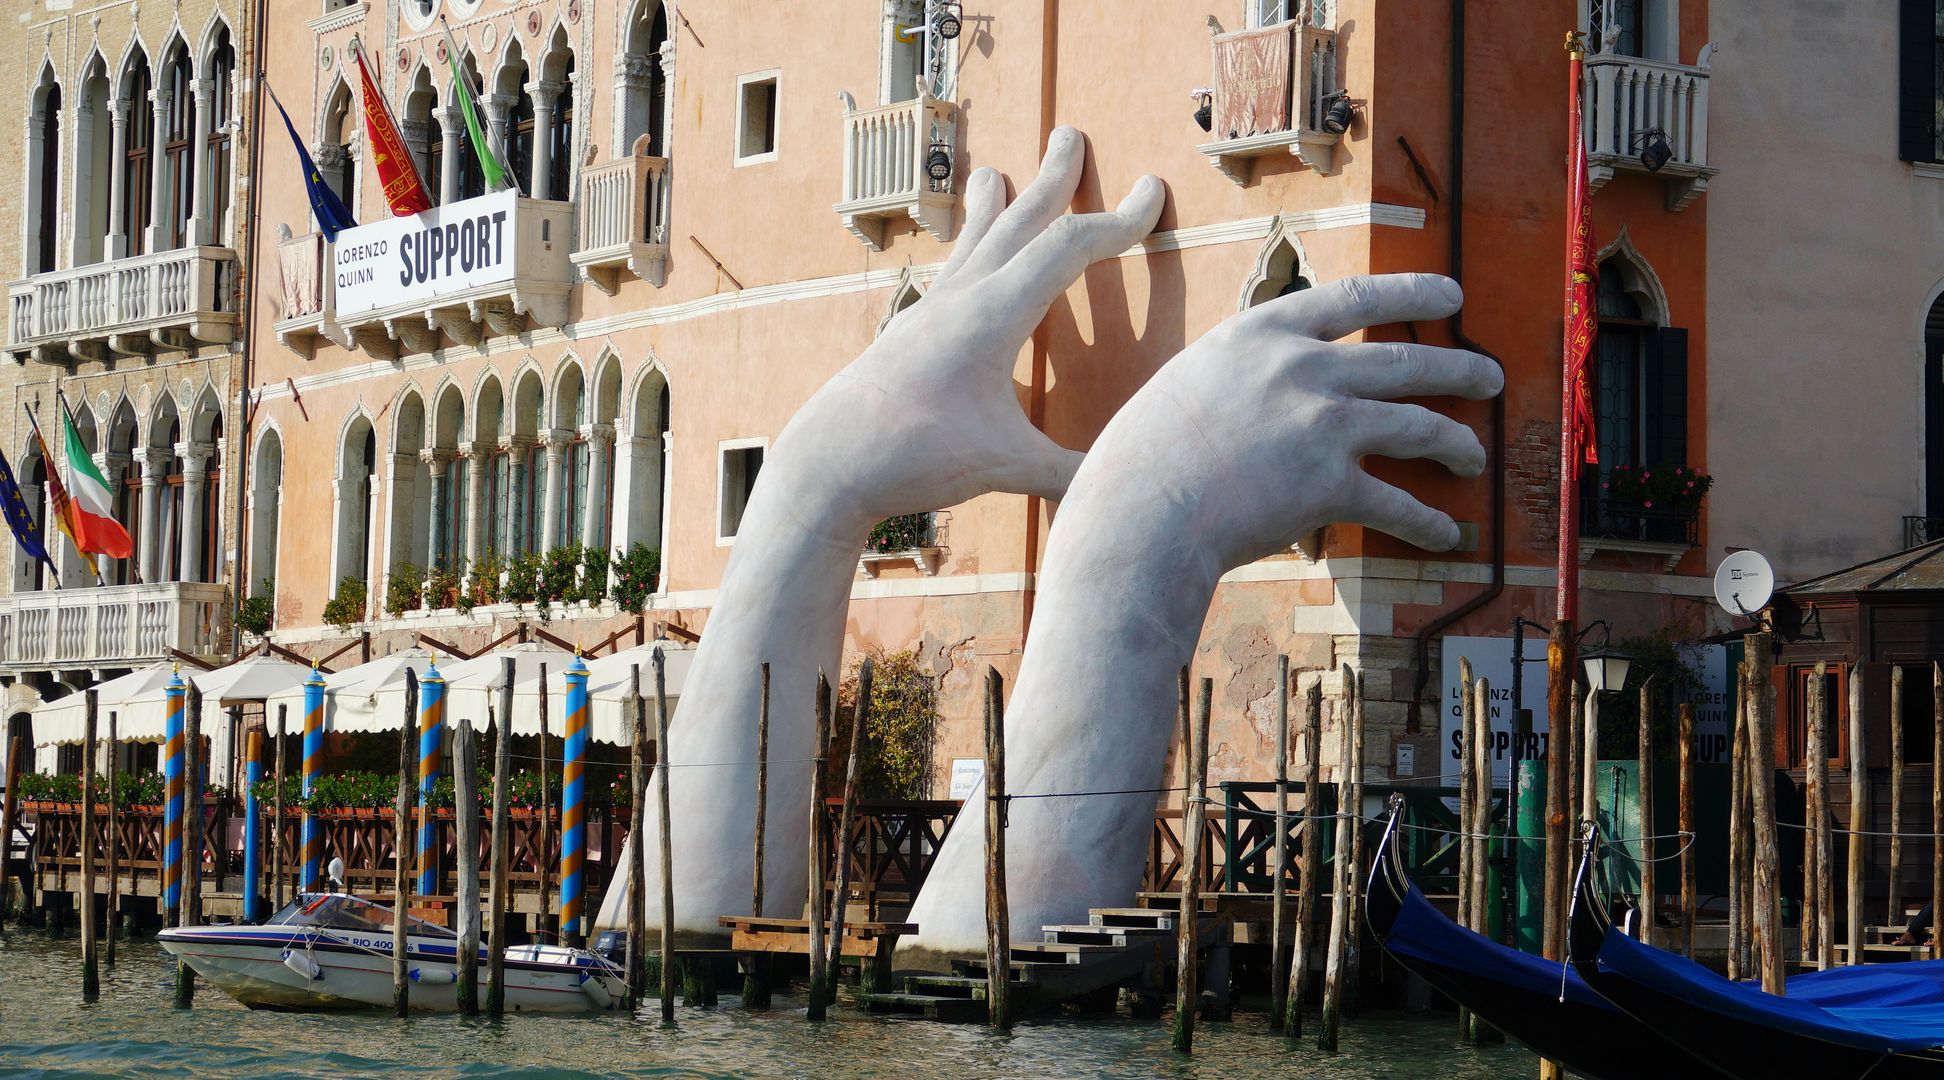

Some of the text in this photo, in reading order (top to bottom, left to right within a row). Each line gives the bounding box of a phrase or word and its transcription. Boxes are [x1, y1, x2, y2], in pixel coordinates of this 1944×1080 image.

[337, 240, 388, 266] LORENZO
[400, 210, 507, 288] SUPPORT
[338, 266, 374, 288] QUINN
[352, 938, 371, 947] RIO
